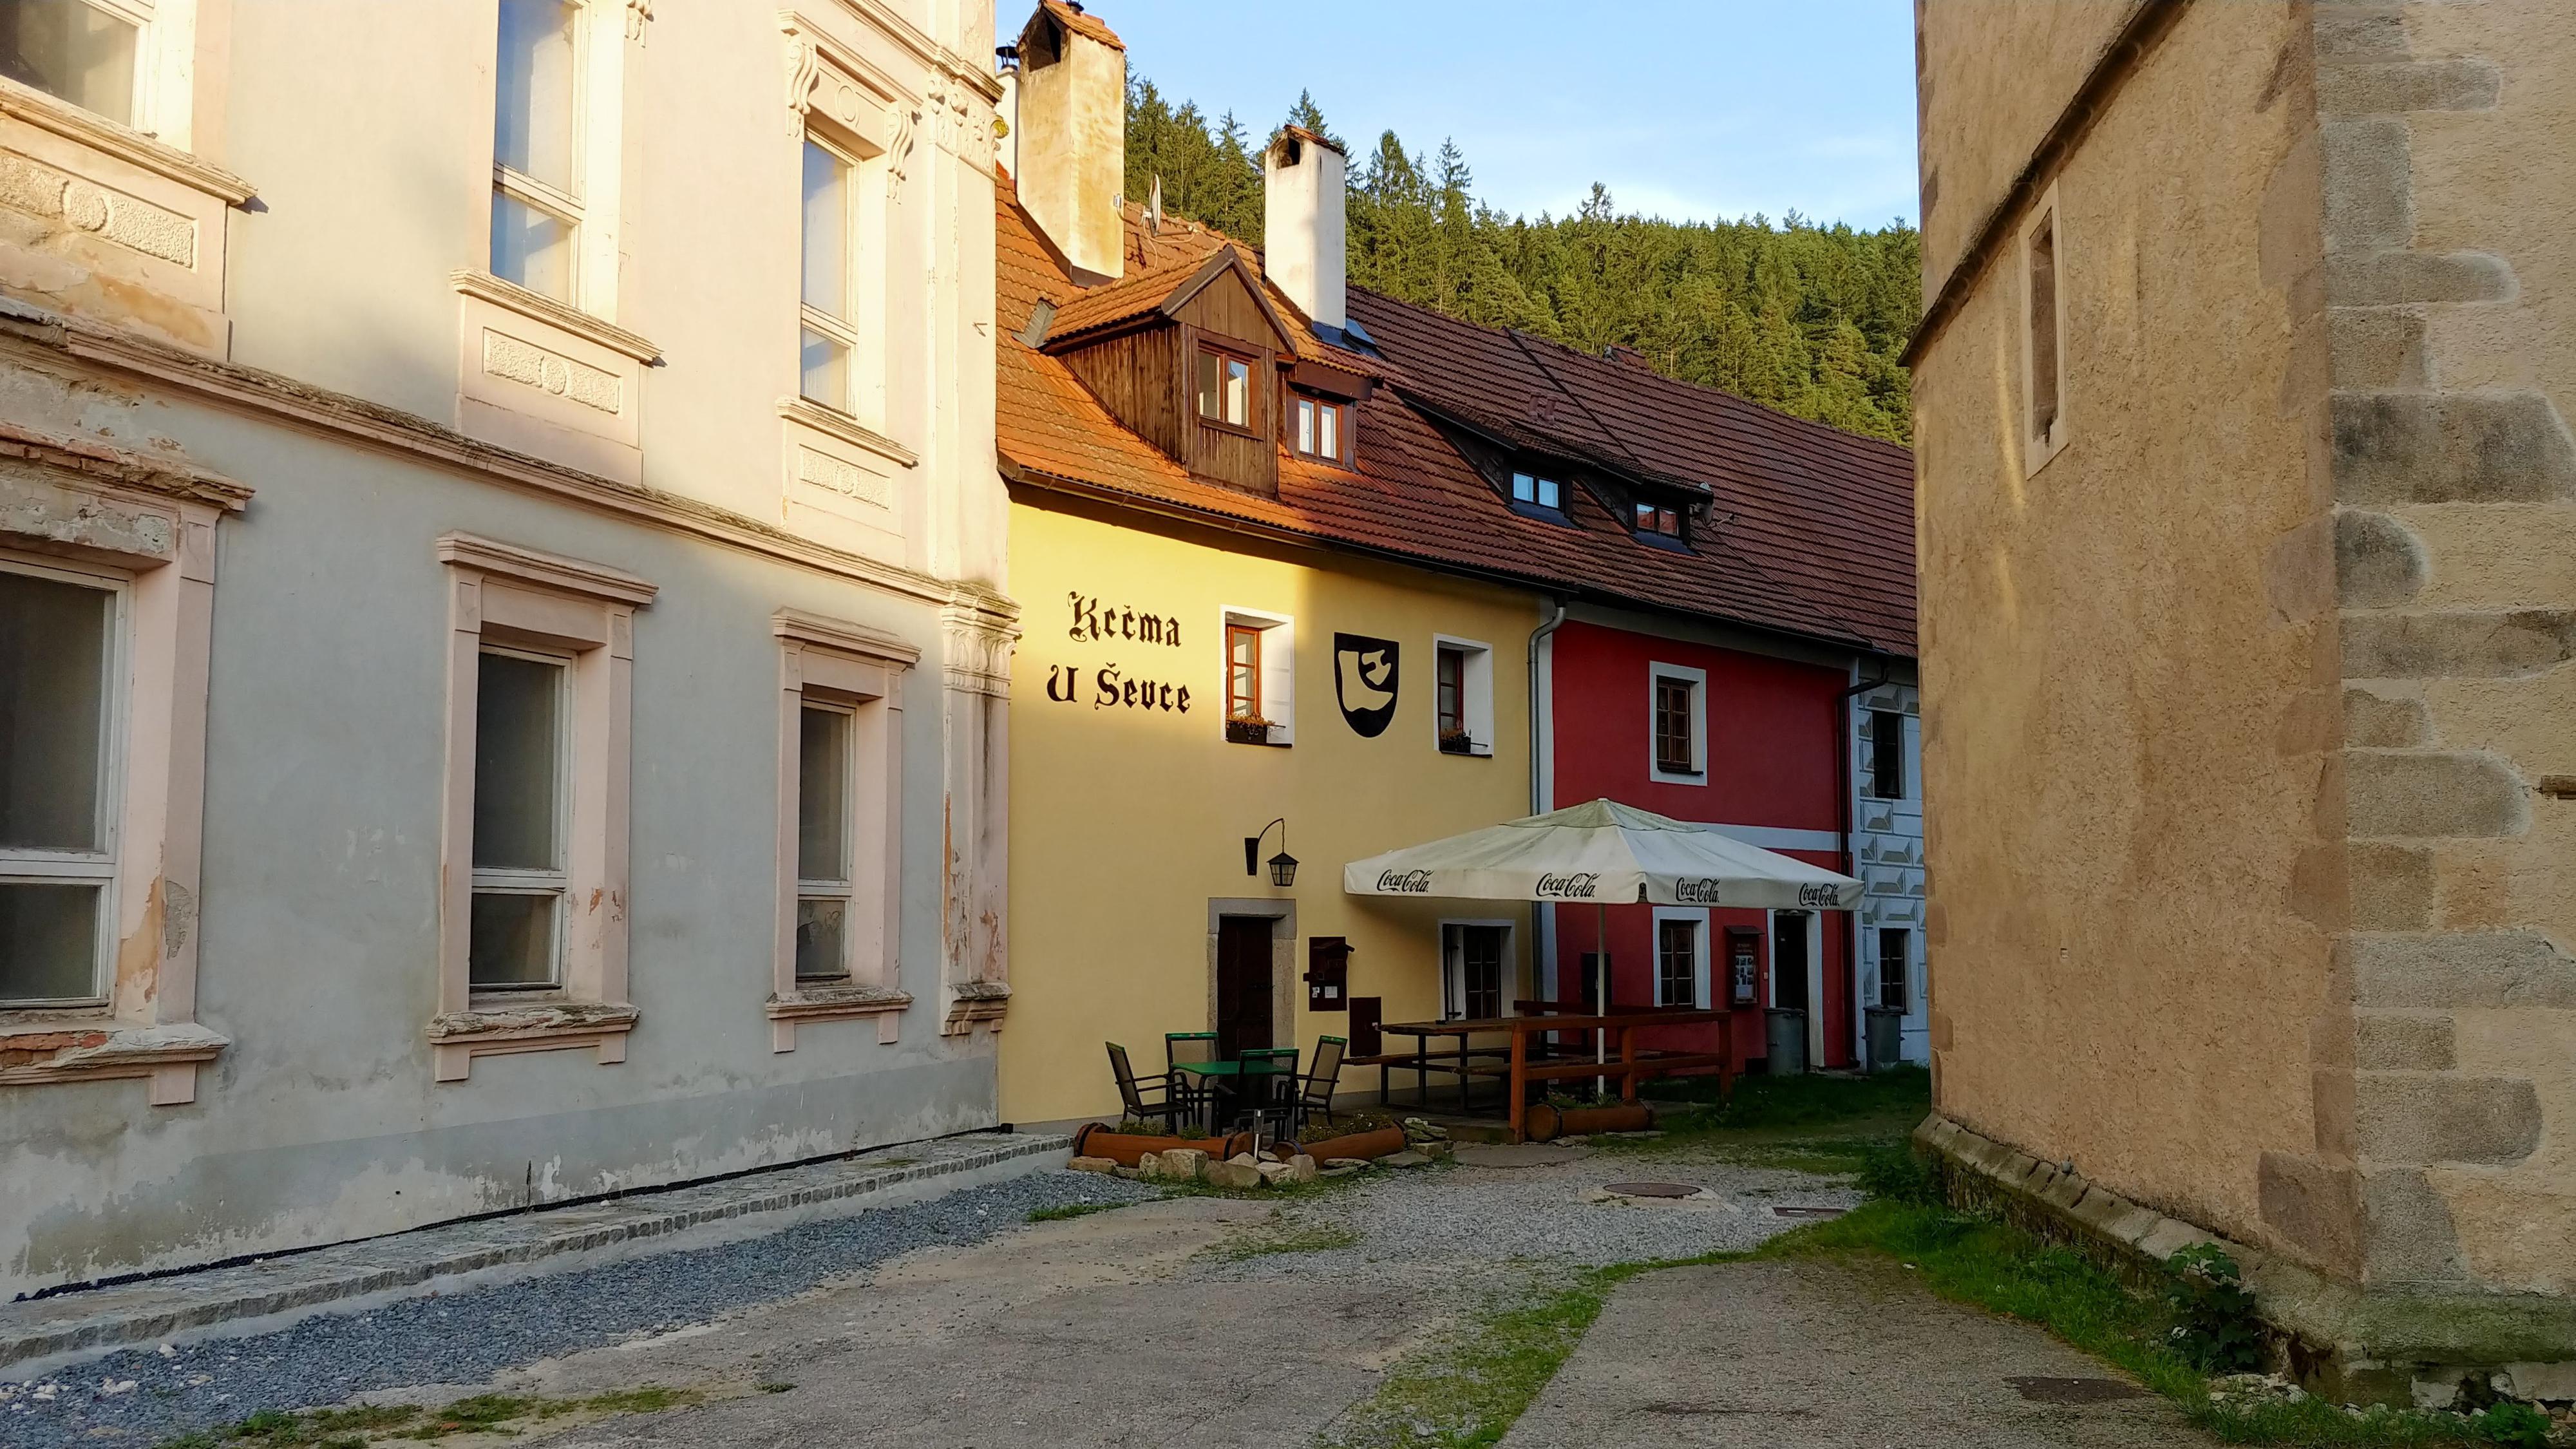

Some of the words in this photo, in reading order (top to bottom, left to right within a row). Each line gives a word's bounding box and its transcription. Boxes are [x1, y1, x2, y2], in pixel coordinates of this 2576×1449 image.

[1046, 664, 1079, 703] U
[1094, 662, 1191, 714] Ševce
[1376, 869, 1434, 893] Coca-Cola
[1535, 873, 1601, 898] Coca-Cola
[1675, 876, 1720, 904] Coca-Cola
[1799, 882, 1840, 907] Coca-Cola
